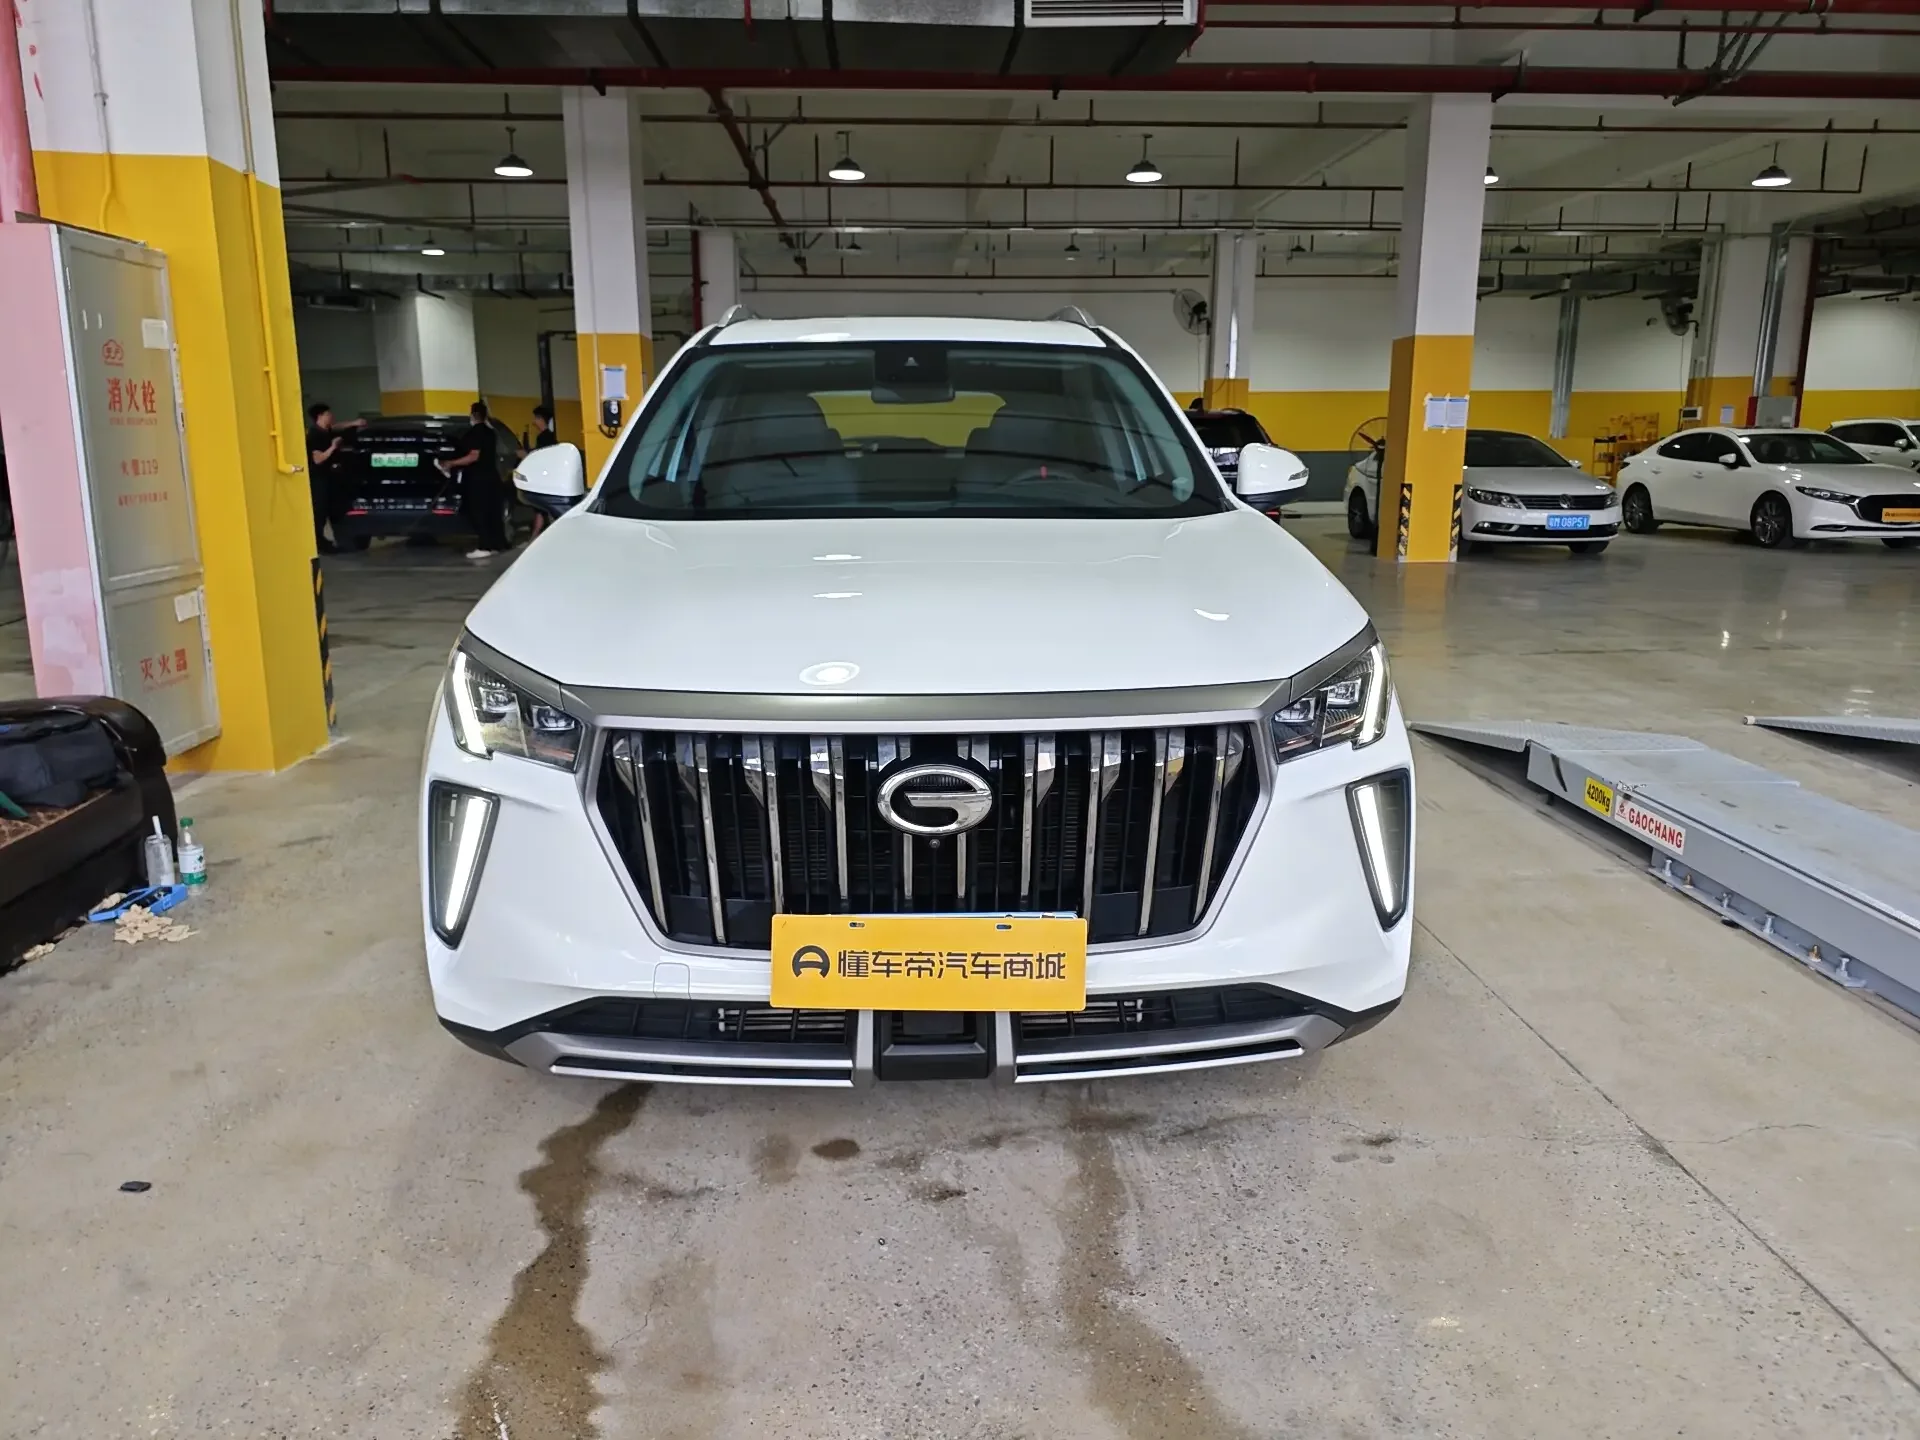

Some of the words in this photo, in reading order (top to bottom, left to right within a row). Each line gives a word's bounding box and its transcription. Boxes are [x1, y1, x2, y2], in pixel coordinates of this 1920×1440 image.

[106, 377, 157, 414] 消火栓
[140, 648, 187, 681] 灭火器
[1586, 783, 1611, 813] 4200kg
[1628, 807, 1683, 849] GAOCHANG
[837, 950, 1067, 980] 懂车帝汽车商城
